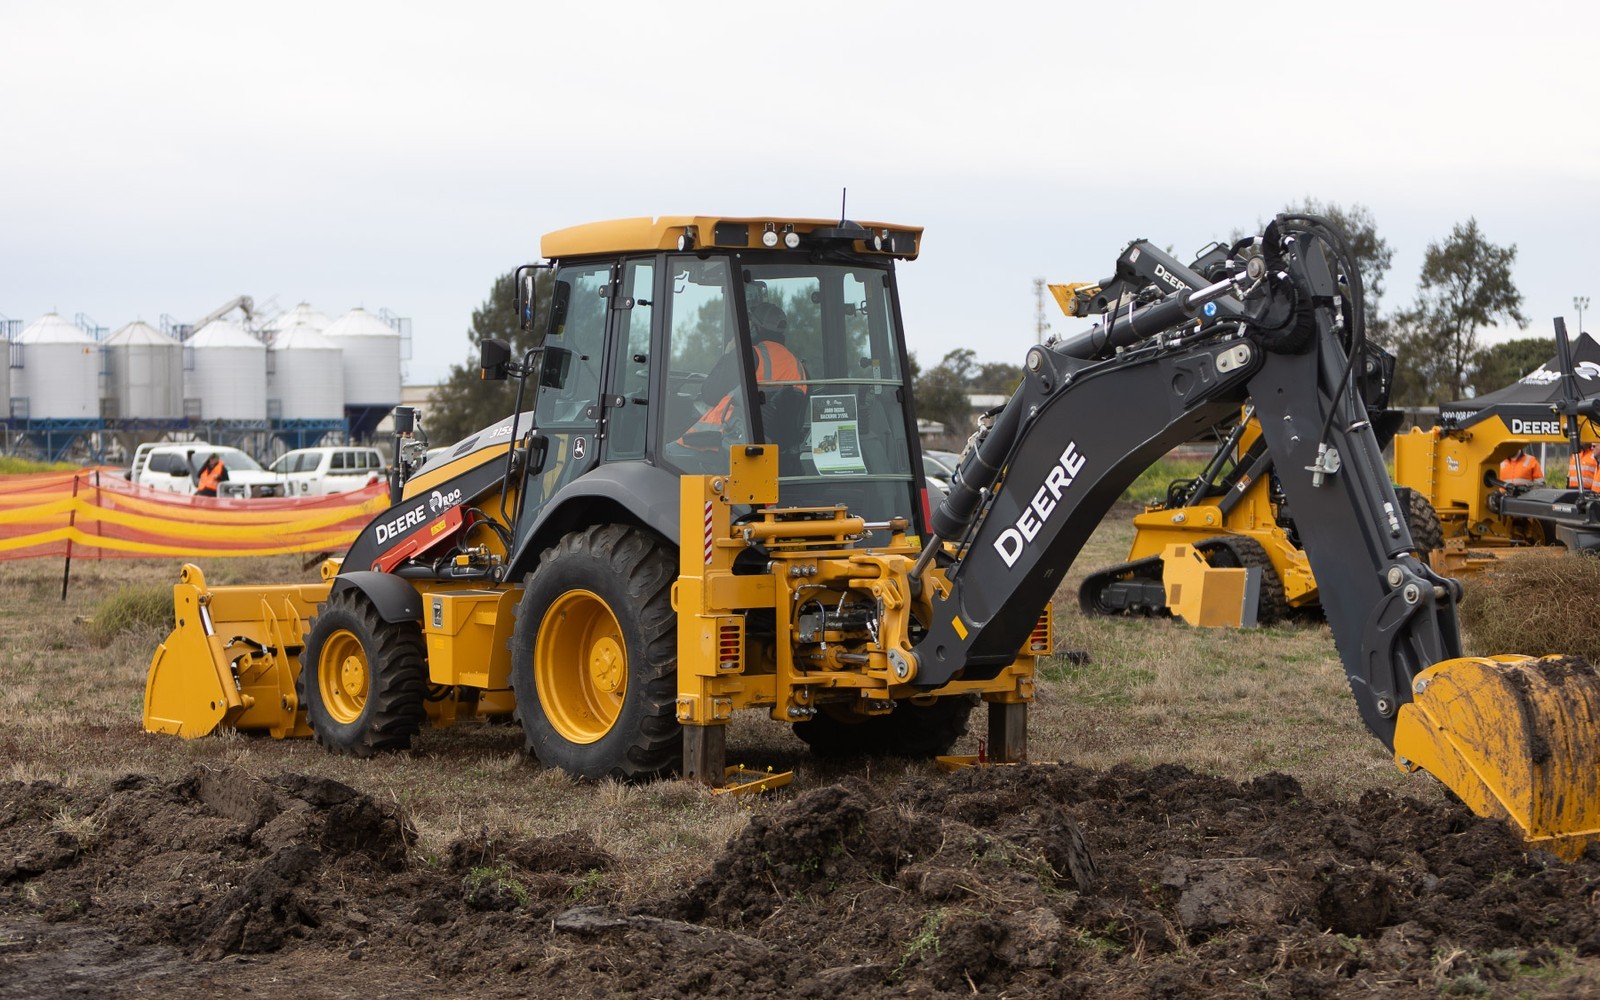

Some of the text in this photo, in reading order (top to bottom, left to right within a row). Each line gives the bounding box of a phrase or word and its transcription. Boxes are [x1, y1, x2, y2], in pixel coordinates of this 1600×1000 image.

[1154, 263, 1193, 291] DEER
[1512, 418, 1560, 434] DEERE
[442, 488, 460, 506] RDO
[993, 440, 1087, 568] DEERE
[375, 504, 427, 545] DEERE
